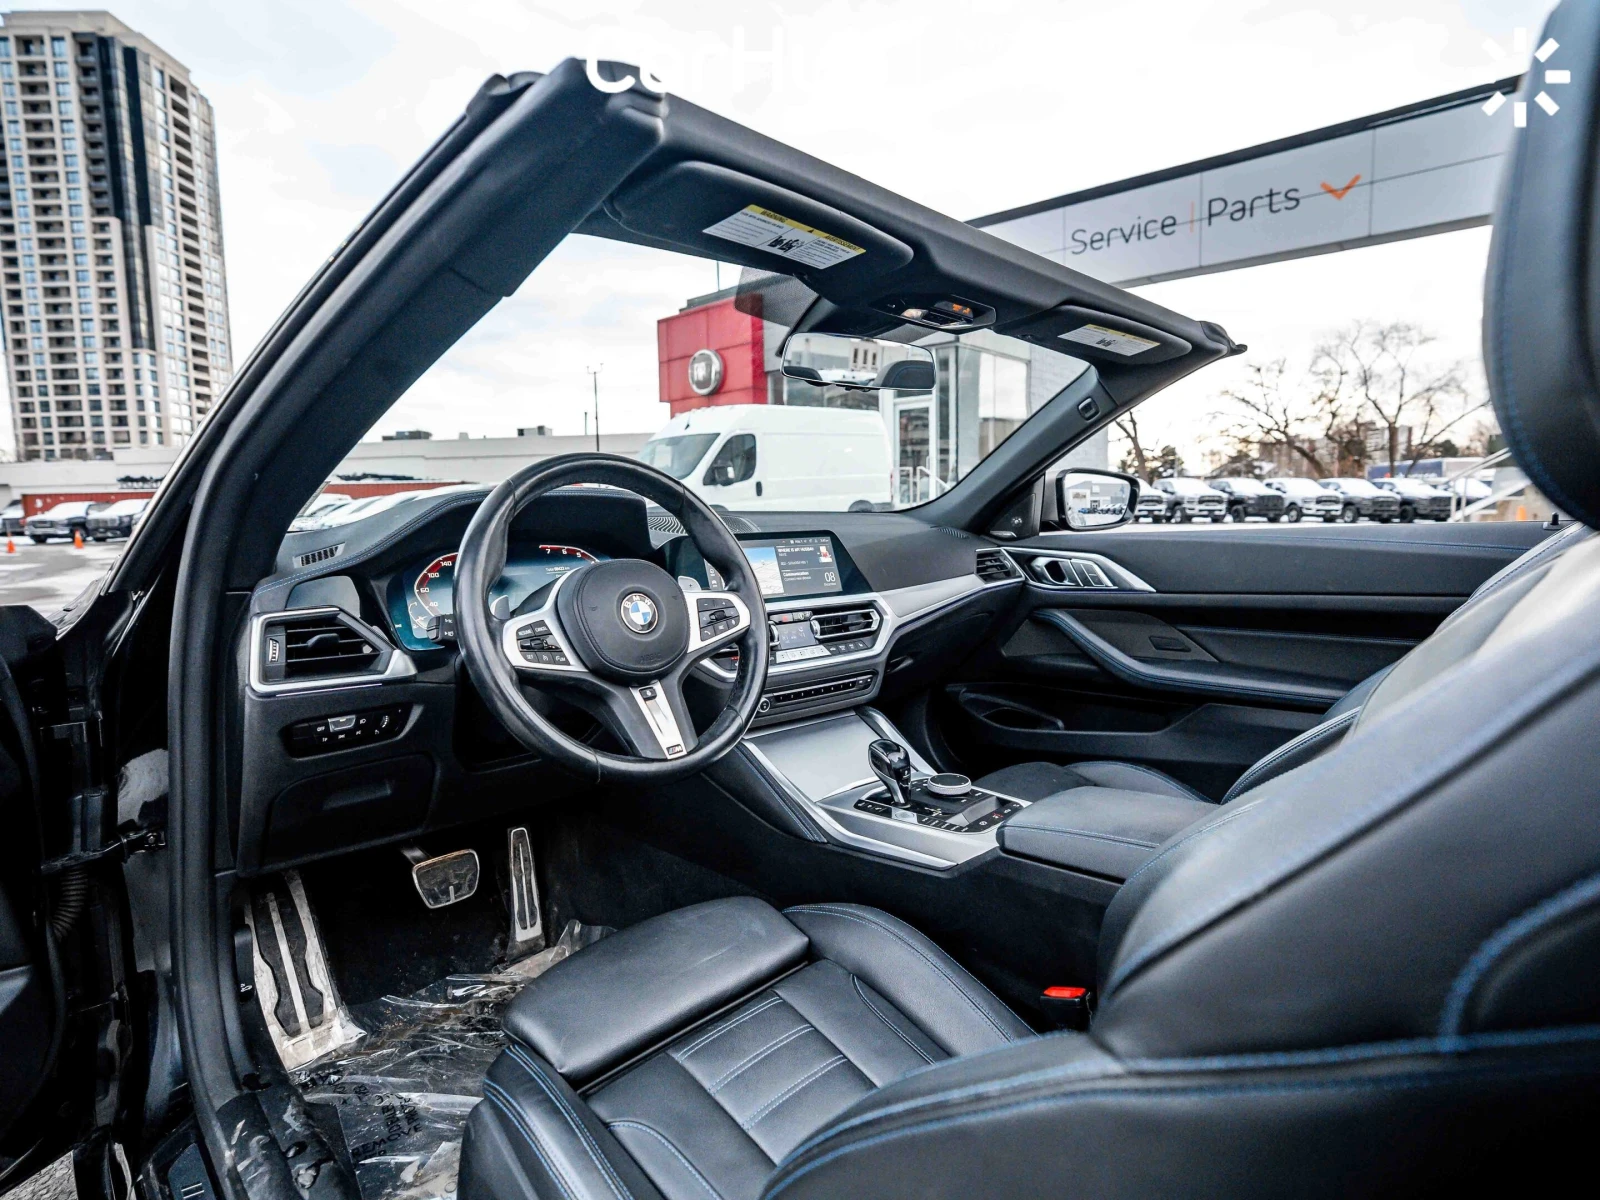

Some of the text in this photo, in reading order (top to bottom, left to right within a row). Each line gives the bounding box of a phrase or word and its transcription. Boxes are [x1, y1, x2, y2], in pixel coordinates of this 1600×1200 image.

[1071, 187, 1301, 255] Service Parts
[825, 572, 835, 582] 08
[624, 594, 652, 608] BMW
